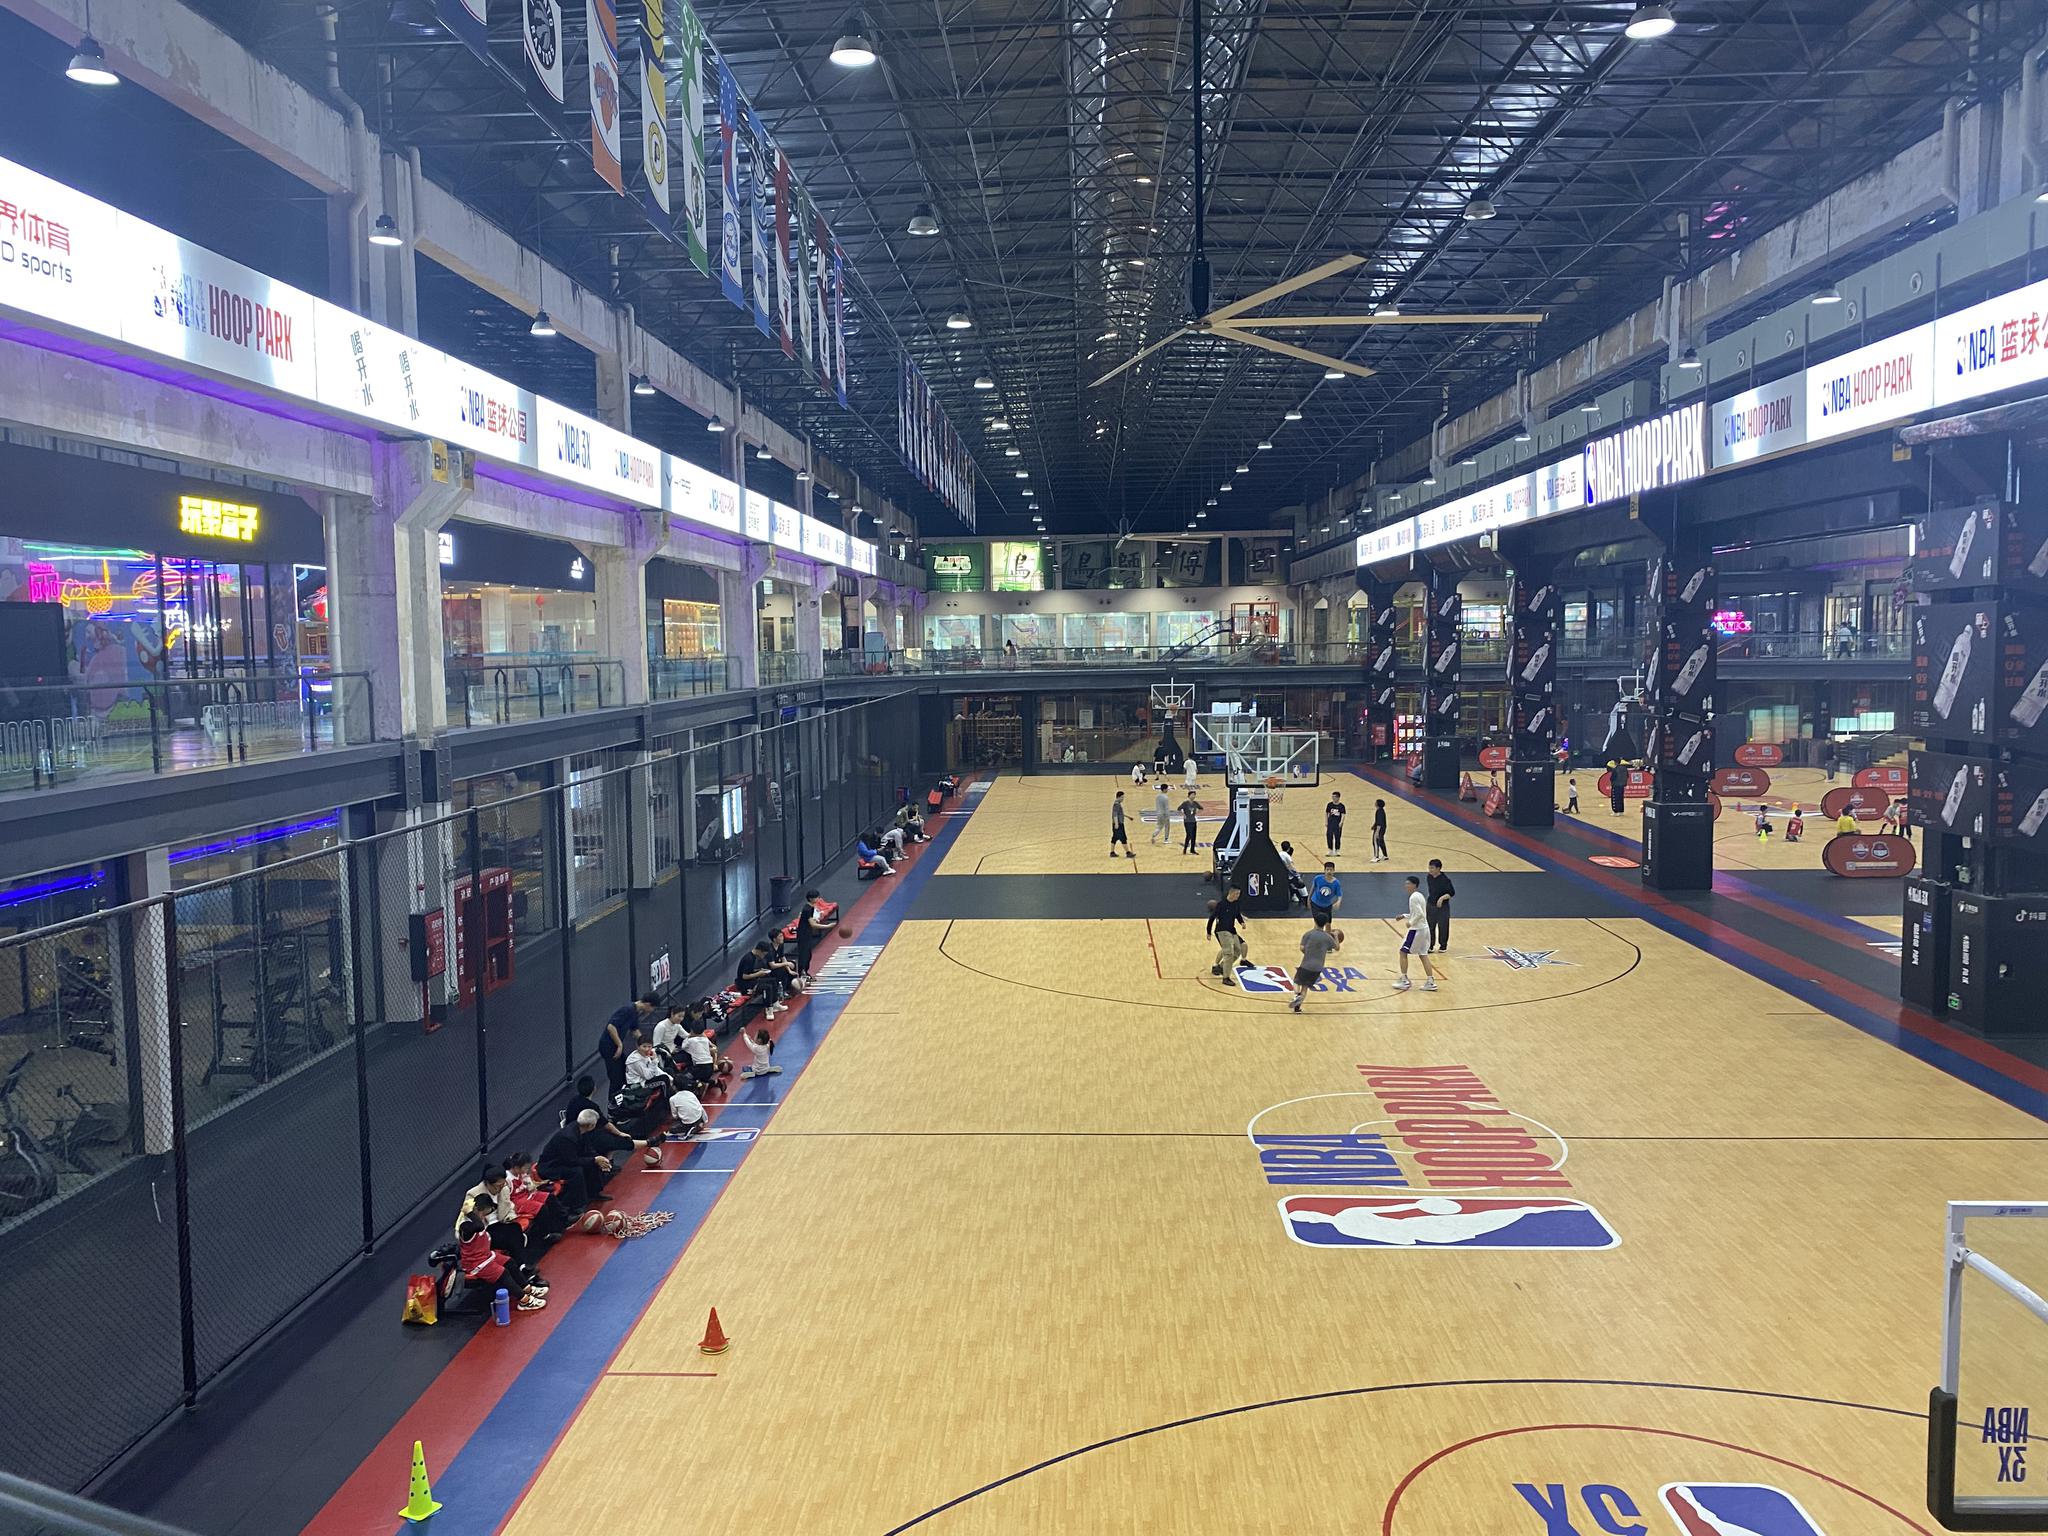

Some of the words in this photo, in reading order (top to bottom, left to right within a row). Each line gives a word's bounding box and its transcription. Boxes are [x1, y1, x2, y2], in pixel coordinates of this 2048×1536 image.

[22, 252, 72, 283] sports
[208, 284, 253, 348] HOOP
[256, 303, 293, 363] PARK
[1968, 325, 1996, 372] NBA
[350, 331, 374, 407] 喝开水
[399, 350, 420, 421] 喝开水
[1831, 375, 1851, 414] NBA
[1853, 364, 1881, 407] HOOP
[1884, 353, 1913, 398] PARK
[468, 389, 486, 430] NBA
[487, 397, 527, 444] 篮球公园
[1730, 412, 1746, 446] NBA
[1747, 405, 1768, 440] HOOP
[1770, 395, 1792, 434] PARK
[564, 422, 581, 466] NBA
[581, 428, 592, 470] 3X
[1595, 433, 1623, 502] NBA
[1623, 418, 1661, 496] HOOP
[1661, 401, 1706, 486] PARK
[1255, 822, 1264, 832] 3
[1356, 1064, 1511, 1115] PARK
[1253, 1134, 1410, 1187] NBA
[1395, 1119, 1573, 1187] HOOP
